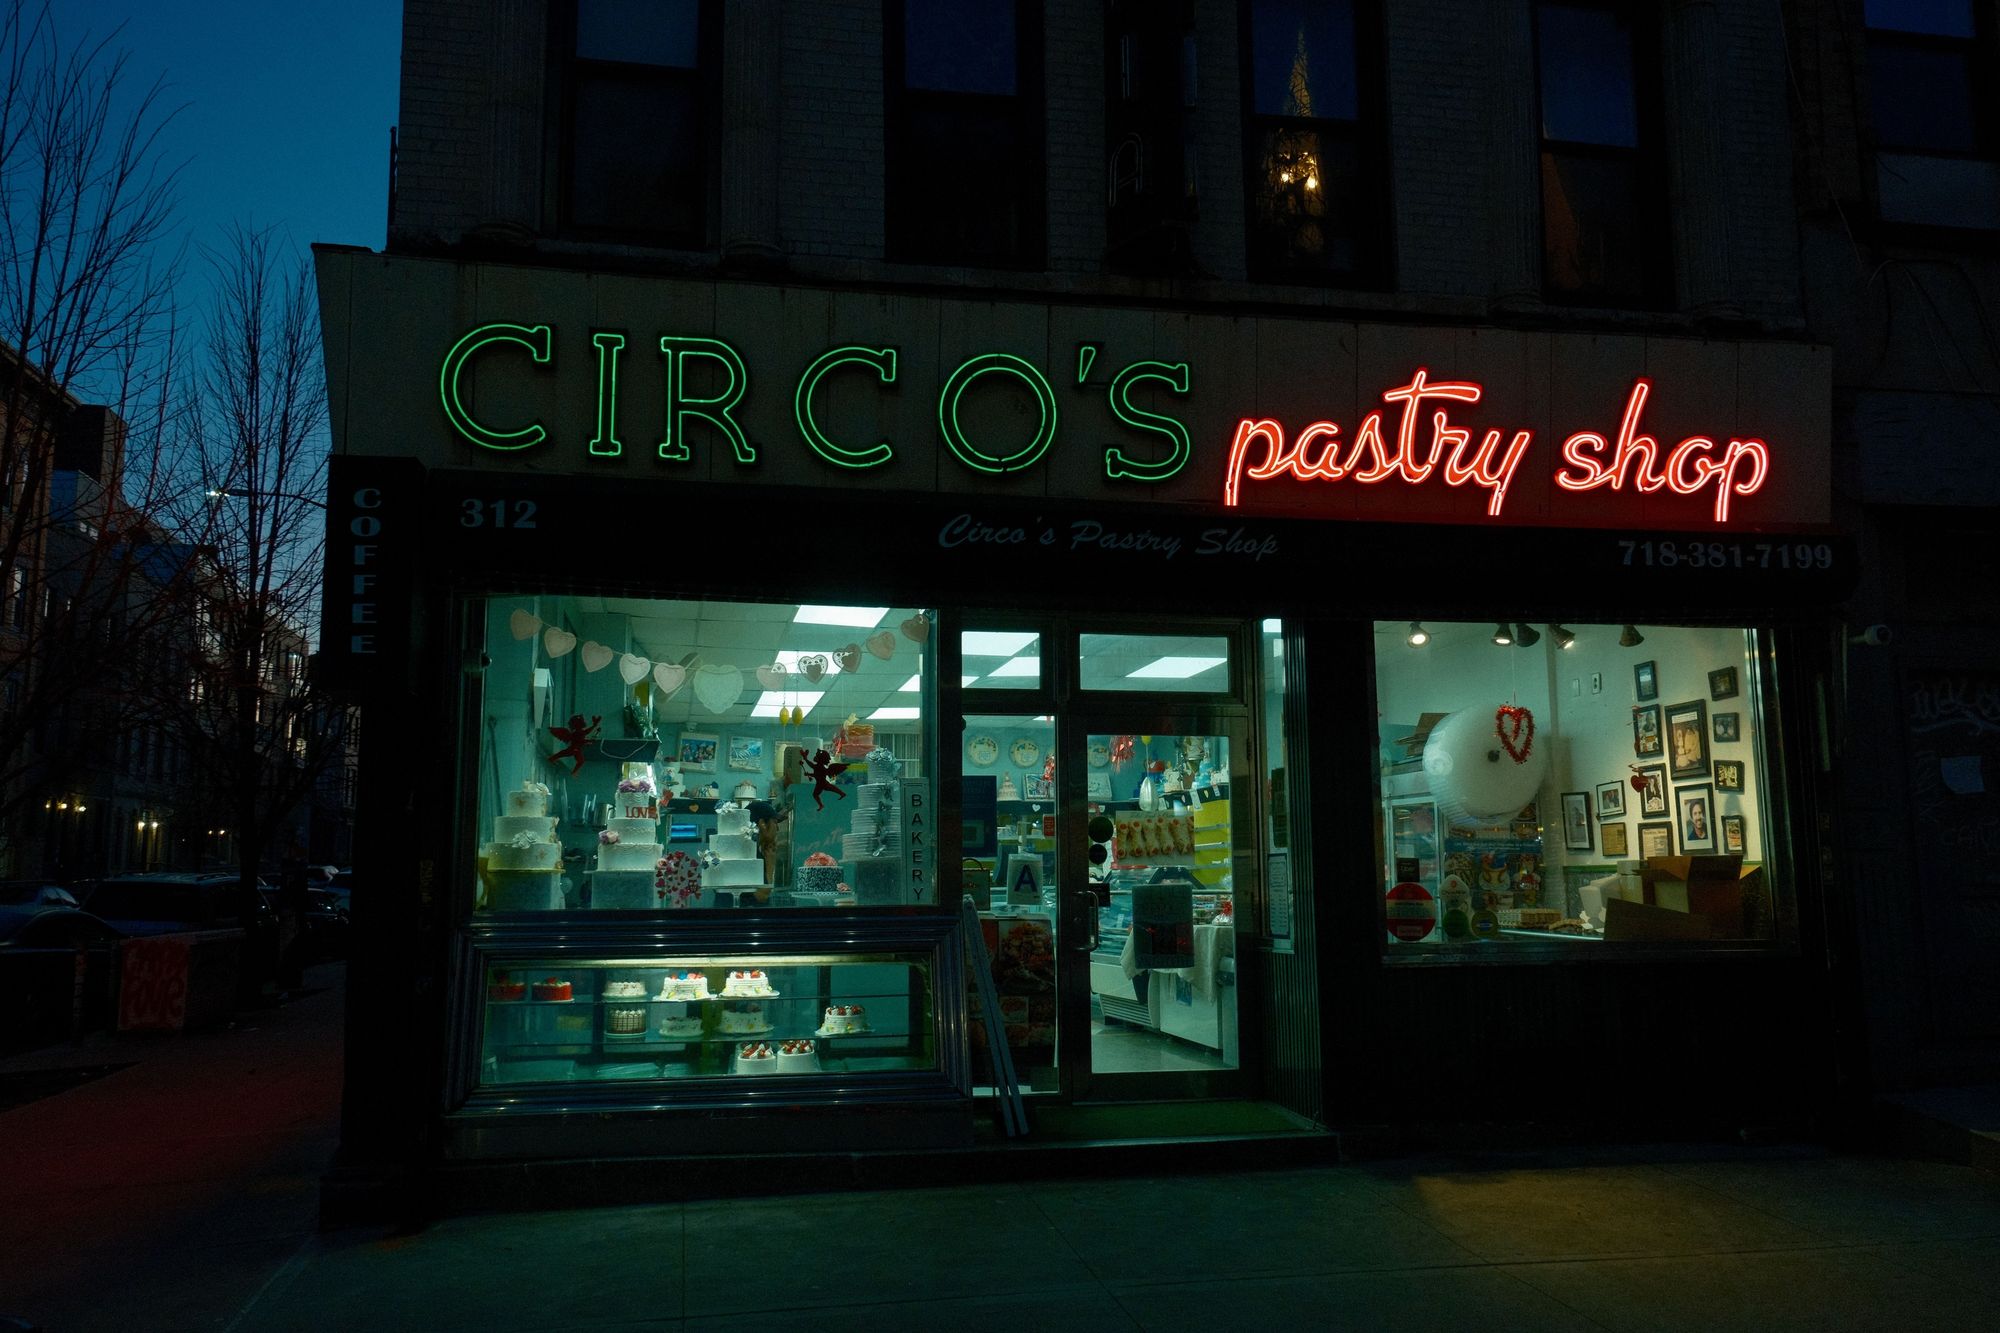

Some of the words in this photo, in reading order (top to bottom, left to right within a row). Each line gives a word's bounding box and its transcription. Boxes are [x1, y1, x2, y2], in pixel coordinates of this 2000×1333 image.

[440, 322, 1192, 482] CIRCO'S
[1223, 369, 1531, 517] pastry
[1555, 381, 1770, 523] shop
[458, 497, 538, 529] 312
[937, 513, 1057, 549] Circo's
[1069, 518, 1184, 560] Pastry
[1195, 525, 1280, 562] Shop
[350, 487, 383, 654] COFFEE
[1616, 539, 1834, 570] 718-381-7199
[911, 793, 924, 900] BAKERY
[1014, 863, 1038, 893] A
